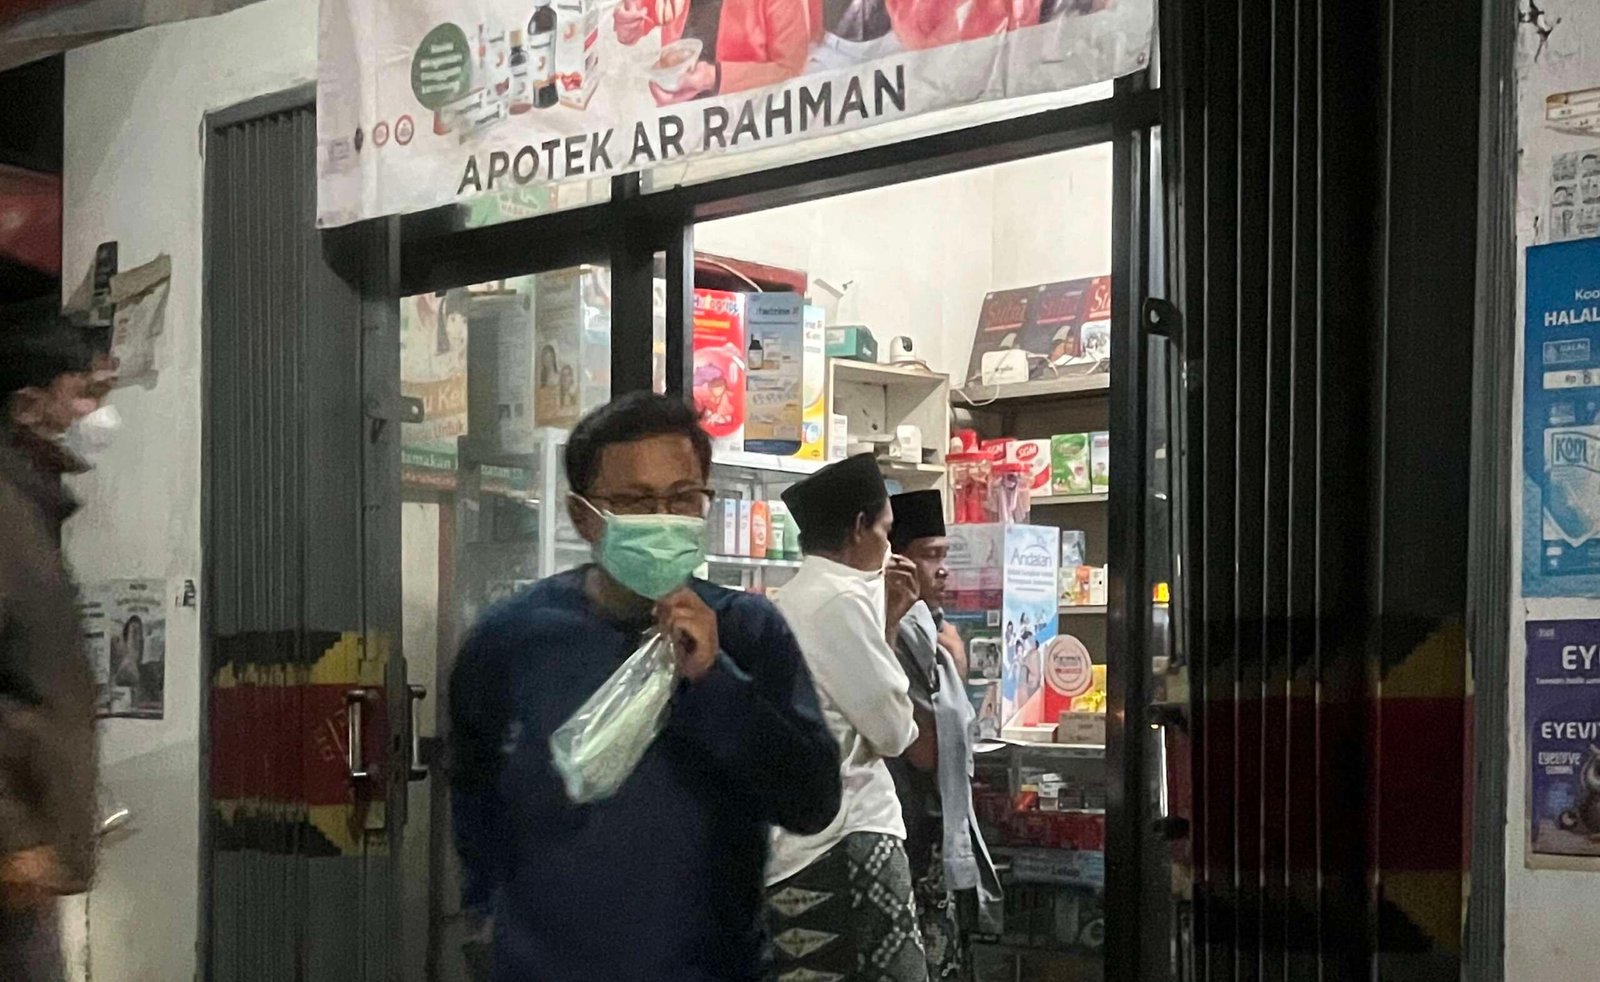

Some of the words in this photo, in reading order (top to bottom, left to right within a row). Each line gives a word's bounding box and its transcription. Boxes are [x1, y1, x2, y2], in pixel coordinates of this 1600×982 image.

[456, 128, 613, 195] APOTEK
[628, 114, 685, 166] AR
[703, 65, 906, 151] RAHMAN
[1544, 307, 1600, 327] HALAL
[1010, 547, 1053, 568] Andalan
[1562, 644, 1600, 670] EY
[1541, 721, 1600, 740] EYEVI
